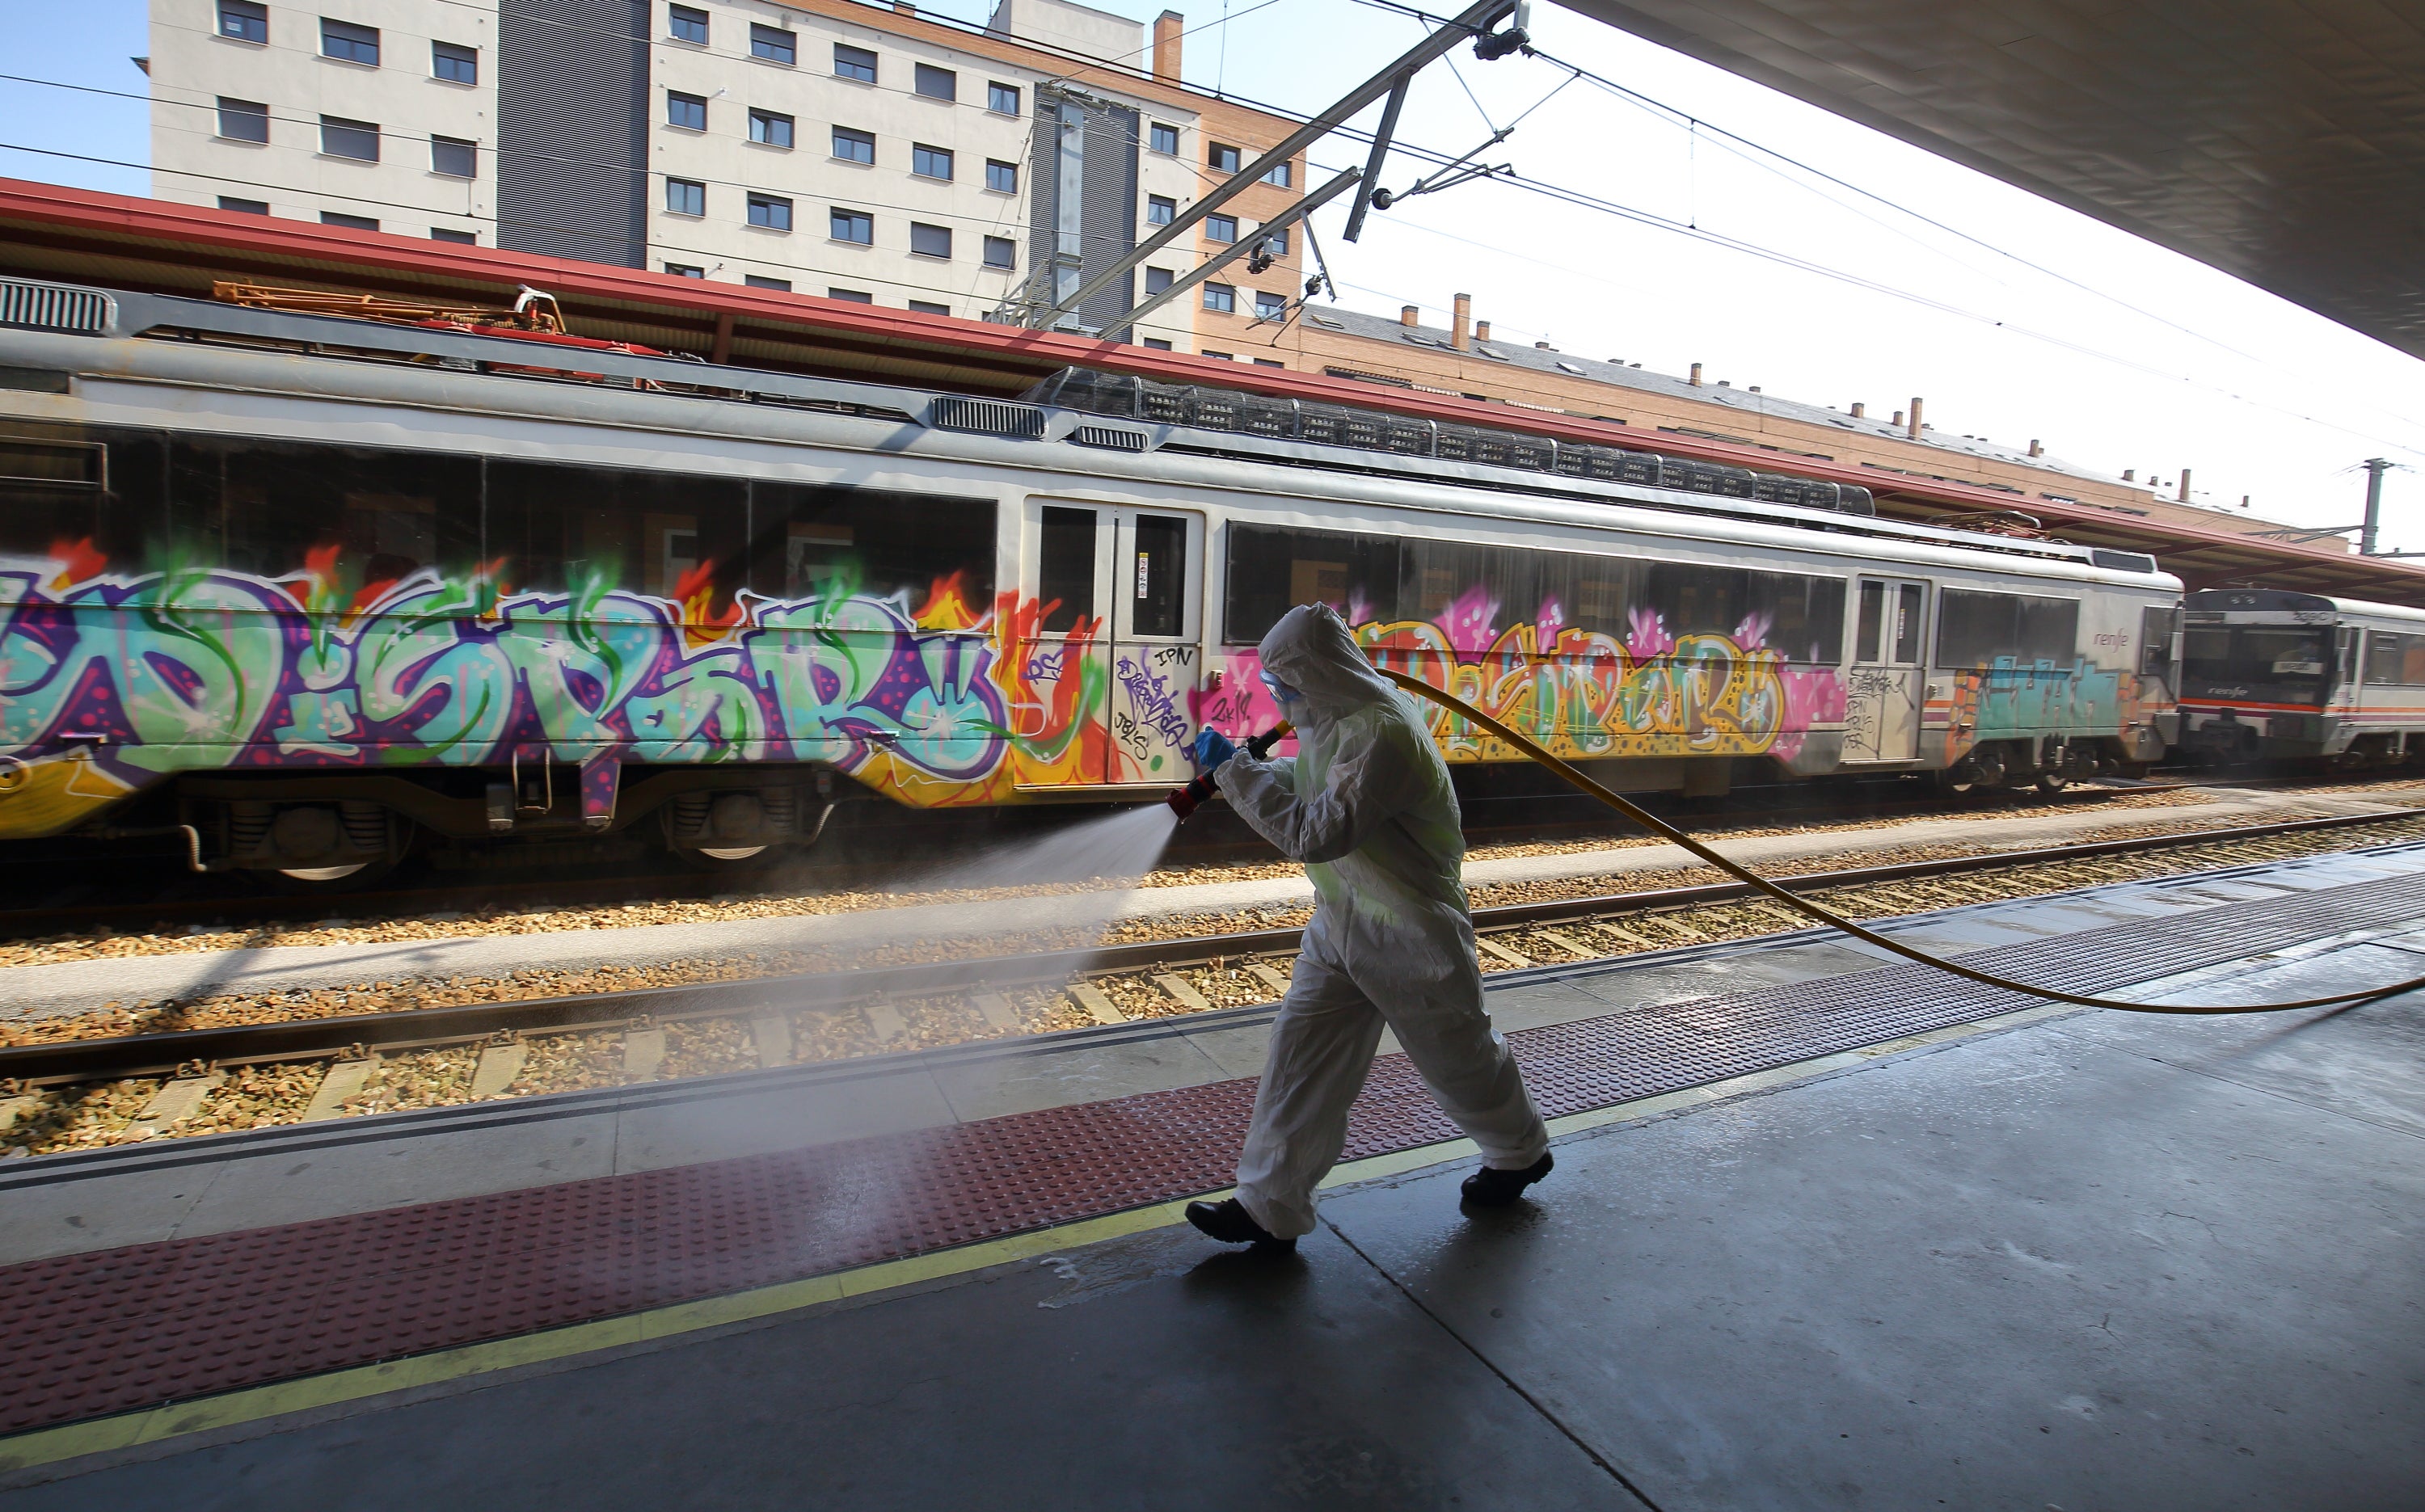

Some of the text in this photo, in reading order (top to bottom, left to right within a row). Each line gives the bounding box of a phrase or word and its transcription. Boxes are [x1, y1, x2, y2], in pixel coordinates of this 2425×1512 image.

[2094, 628, 2129, 653] renfe
[1154, 647, 1192, 666] IPN
[2208, 686, 2249, 698] renfe
